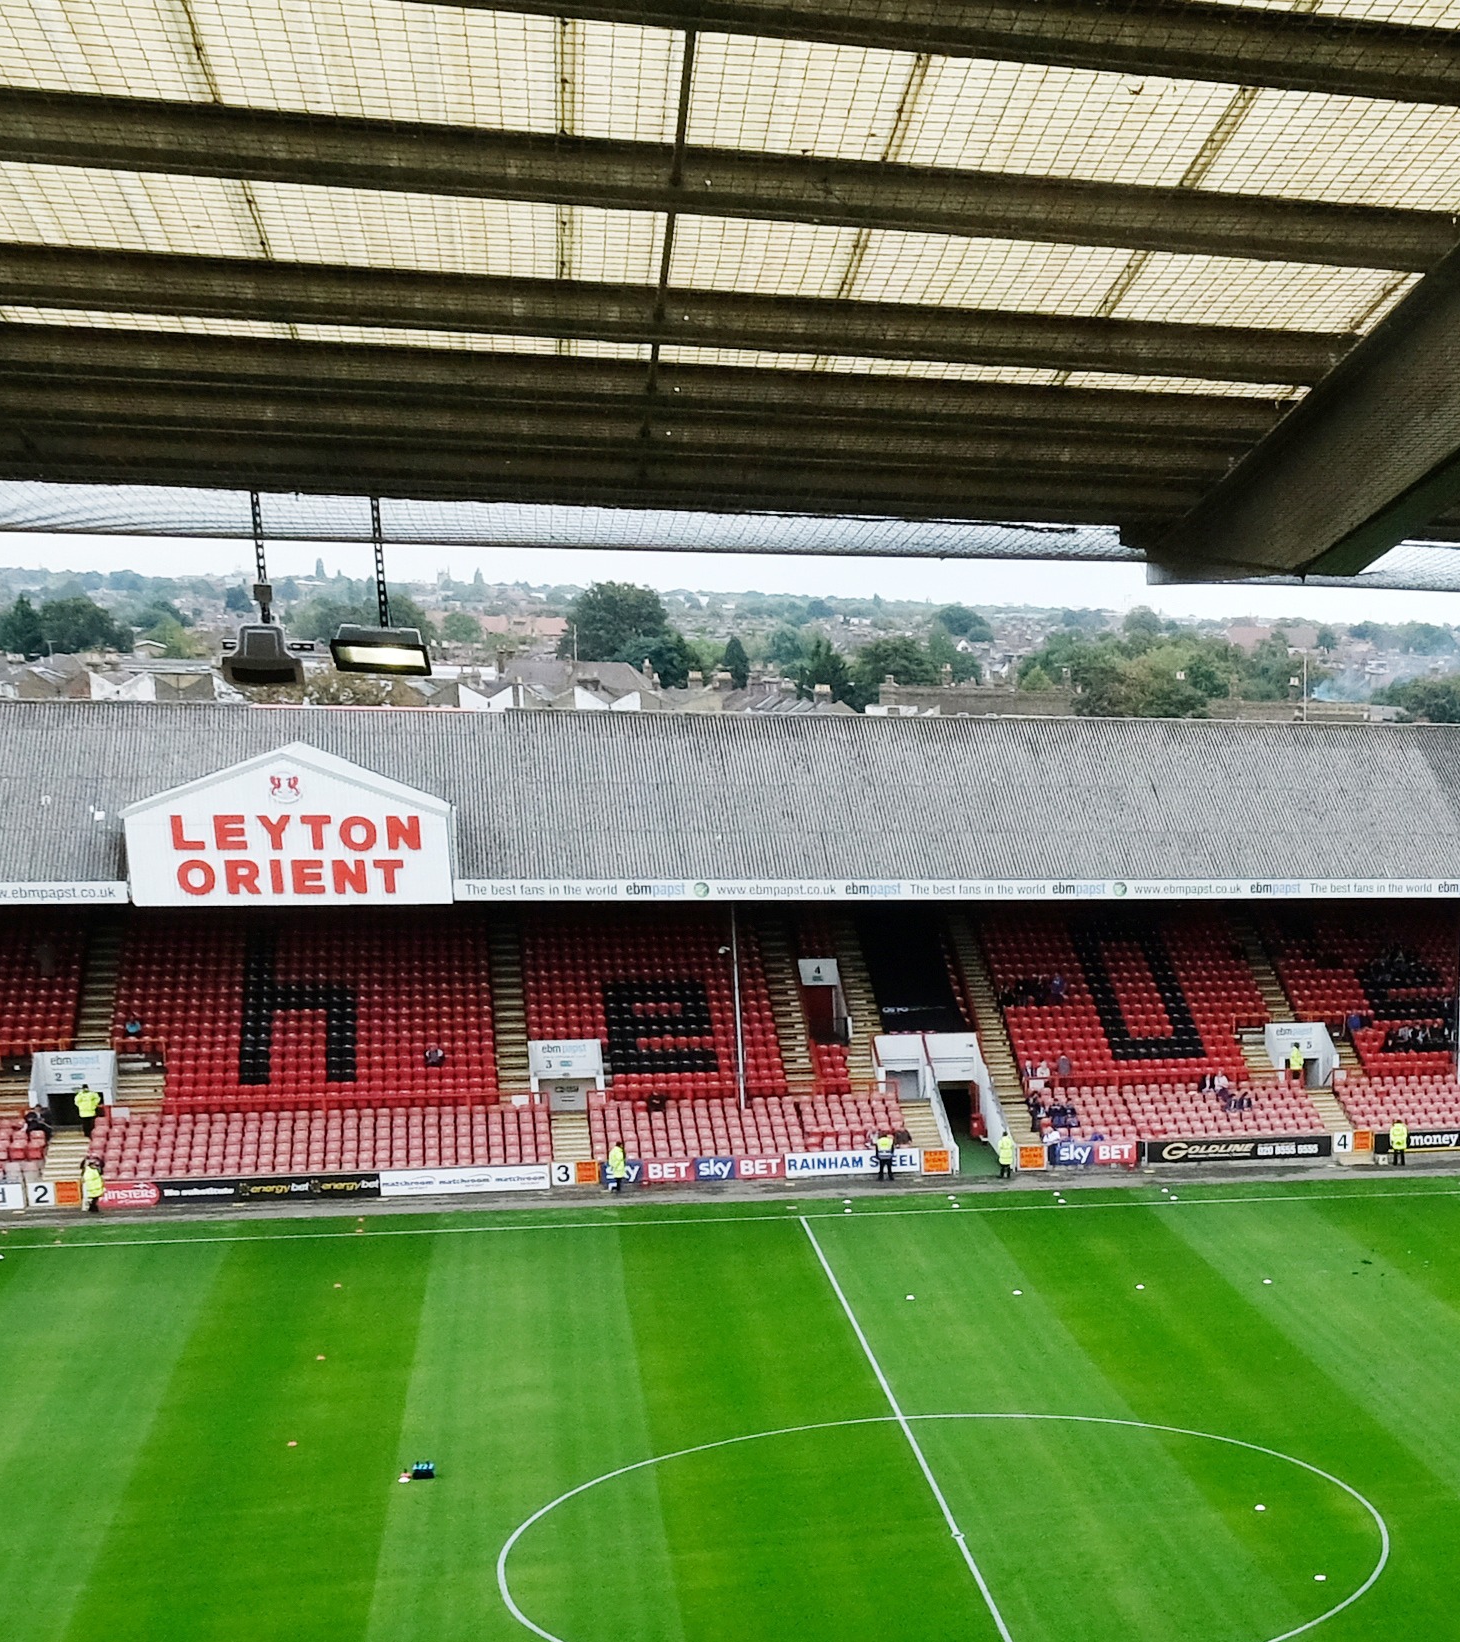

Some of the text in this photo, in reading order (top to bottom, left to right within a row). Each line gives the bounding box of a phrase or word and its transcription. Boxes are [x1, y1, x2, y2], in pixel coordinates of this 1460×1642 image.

[170, 813, 421, 852] LEYTON
[177, 857, 404, 895] ORIENT
[1337, 1134, 1348, 1150] 4
[1410, 1132, 1457, 1149] money
[1059, 1142, 1093, 1164] sky
[1100, 1142, 1133, 1159] BET
[1161, 1142, 1255, 1160] GOLDLINE
[648, 1162, 690, 1179] BET
[697, 1158, 781, 1180] sky BET
[787, 1154, 864, 1172] RAINHAM
[556, 1164, 570, 1183] 3
[33, 1185, 50, 1203] 2
